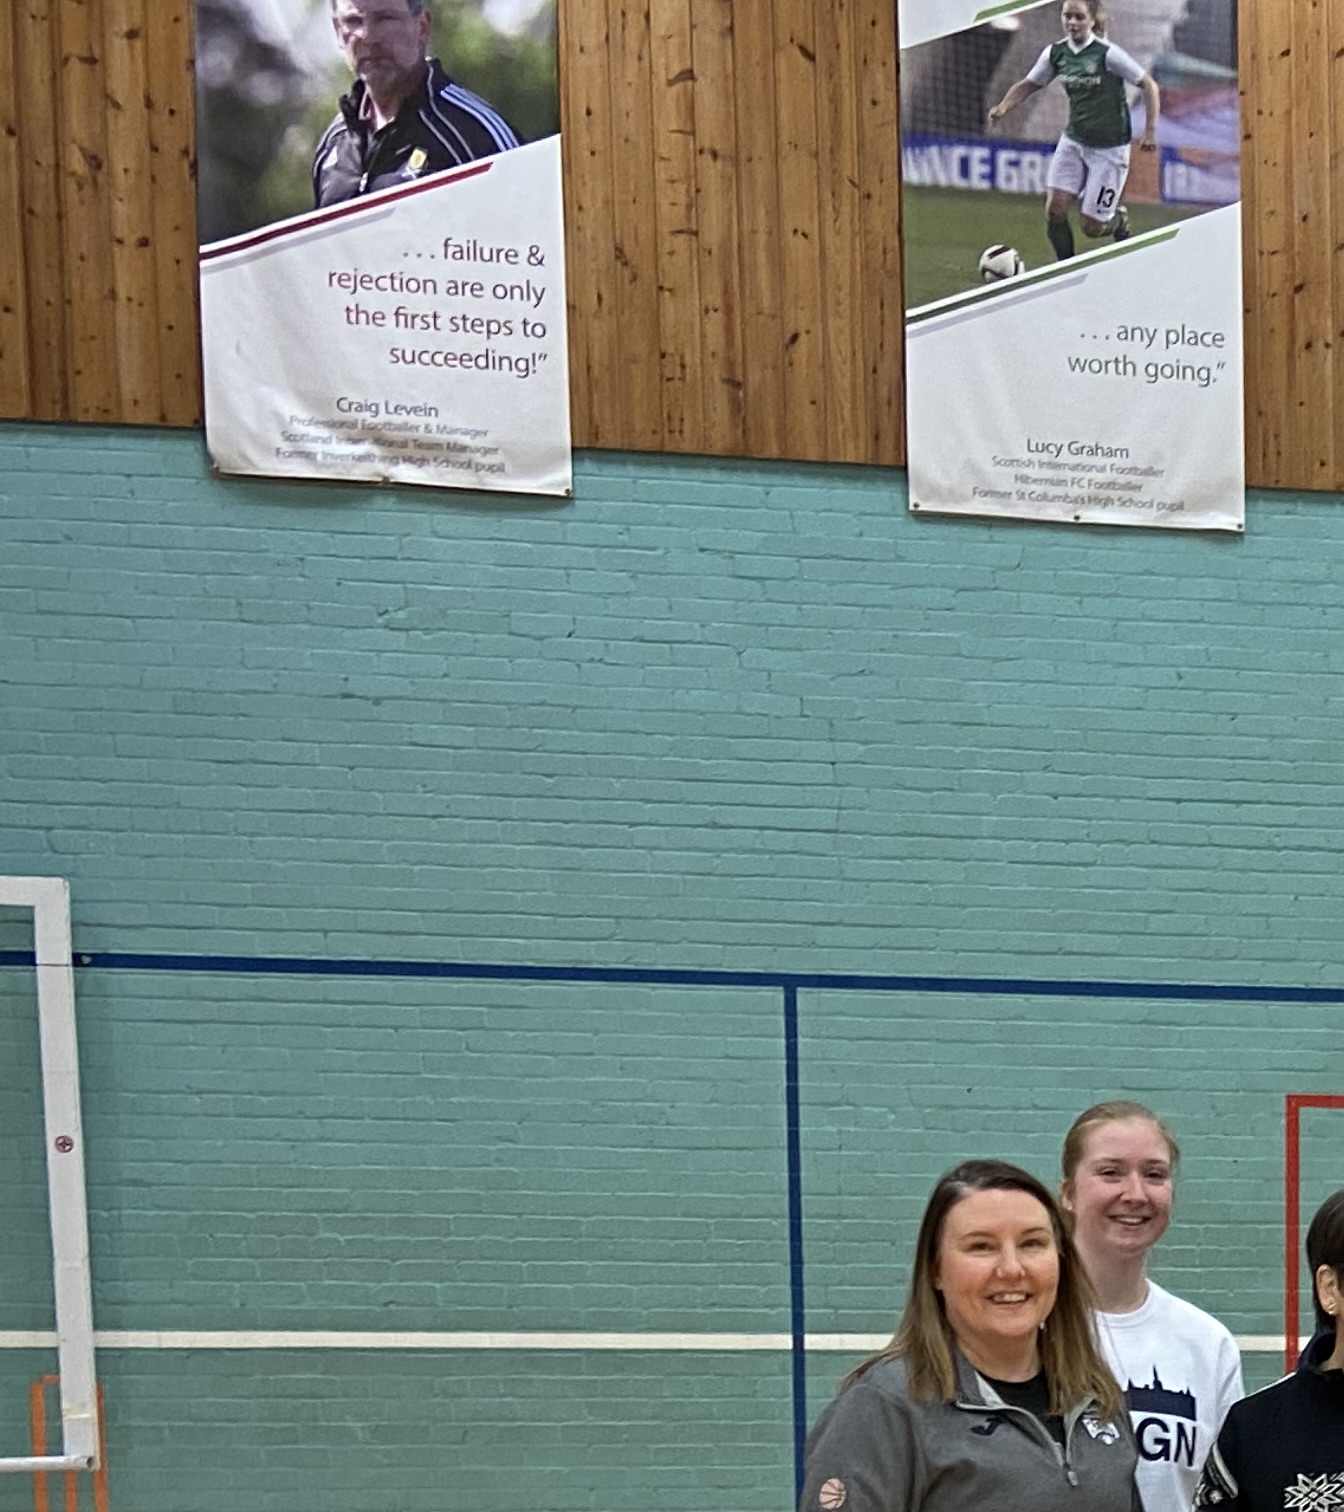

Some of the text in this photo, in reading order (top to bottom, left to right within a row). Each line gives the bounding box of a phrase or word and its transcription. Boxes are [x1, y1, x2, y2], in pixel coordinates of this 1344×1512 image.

[1096, 186, 1116, 209] 13
[443, 236, 520, 266] failure
[527, 244, 546, 267] &
[328, 267, 546, 309] rejection are only
[345, 303, 547, 340] the first steps to
[1116, 324, 1158, 350] any
[1165, 323, 1226, 350] place
[1067, 354, 1137, 378] worth
[336, 396, 439, 418] Craig Levein
[1026, 438, 1130, 459] Lucy Graham
